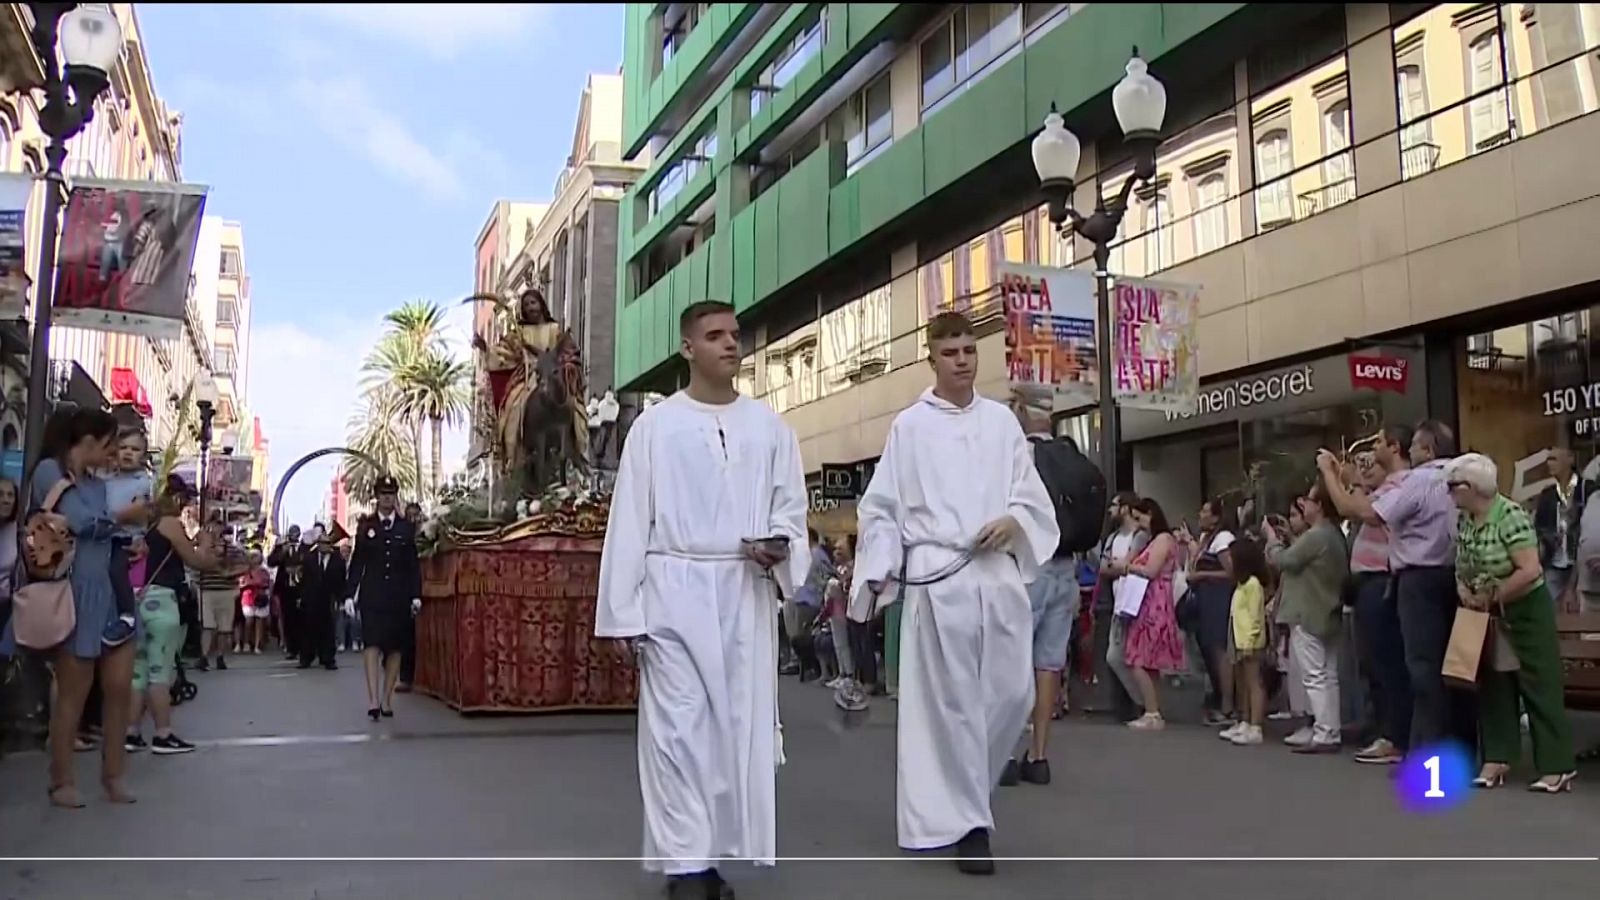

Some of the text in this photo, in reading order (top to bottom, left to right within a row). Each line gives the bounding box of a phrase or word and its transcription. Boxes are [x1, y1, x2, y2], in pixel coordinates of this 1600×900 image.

[1116, 285, 1160, 324] ISLA
[1165, 365, 1314, 421] wmen'secret
[1542, 388, 1577, 415] 150
[1575, 418, 1590, 434] OF
